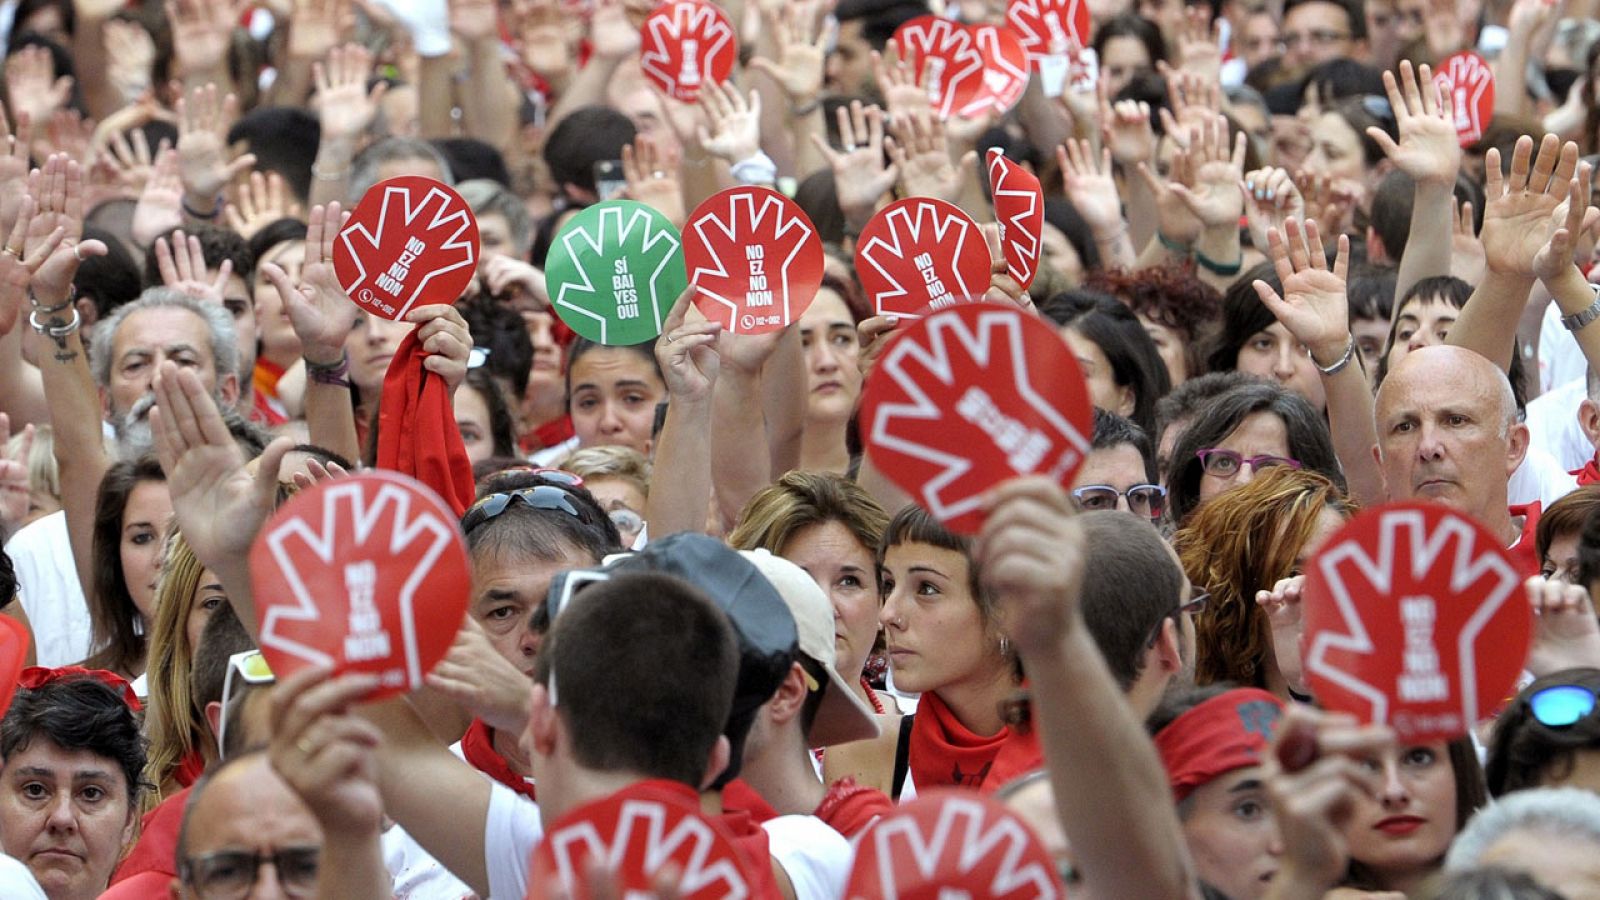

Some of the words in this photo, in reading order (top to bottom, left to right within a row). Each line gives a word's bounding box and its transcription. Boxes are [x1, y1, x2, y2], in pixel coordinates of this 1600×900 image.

[405, 236, 426, 256] NO
[745, 244, 764, 260] NO
[397, 250, 417, 269] EZ
[614, 255, 628, 275] SÍ
[749, 260, 765, 275] EZ
[914, 252, 933, 271] NO
[387, 262, 409, 281] NO
[921, 266, 938, 284] EZ
[375, 272, 404, 297] NON
[612, 274, 634, 290] BAI
[749, 275, 767, 291] NO
[926, 280, 946, 298] NO
[613, 289, 638, 304] YES
[746, 290, 773, 307] NON
[617, 303, 639, 319] OUI
